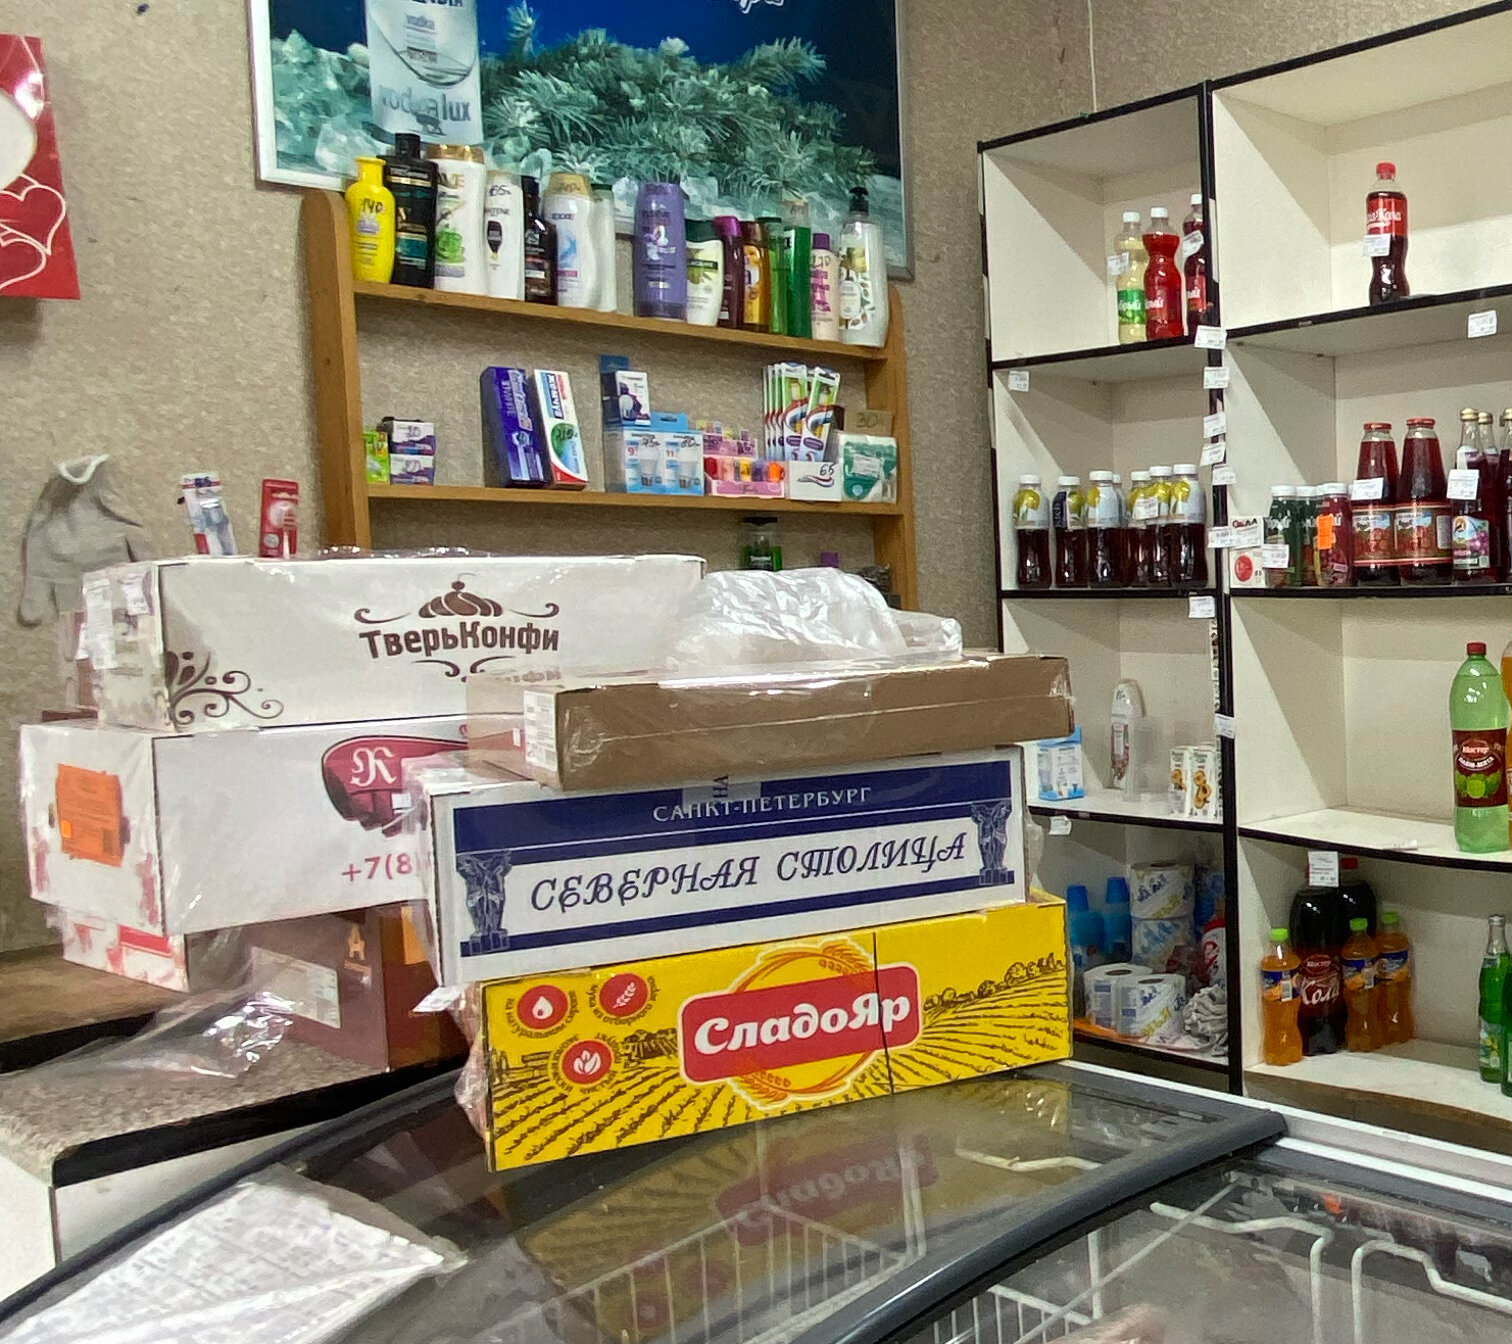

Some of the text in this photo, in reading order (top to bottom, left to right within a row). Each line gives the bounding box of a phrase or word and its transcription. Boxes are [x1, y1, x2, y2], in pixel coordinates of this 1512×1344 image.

[359, 622, 560, 660] ТверьКонфи
[652, 786, 873, 823] САНКТ-ПЕТЕРБУРГ
[531, 831, 967, 914] СЕВЕРНАЯ СТОЛИЦА
[694, 992, 912, 1056] СладоЯр
